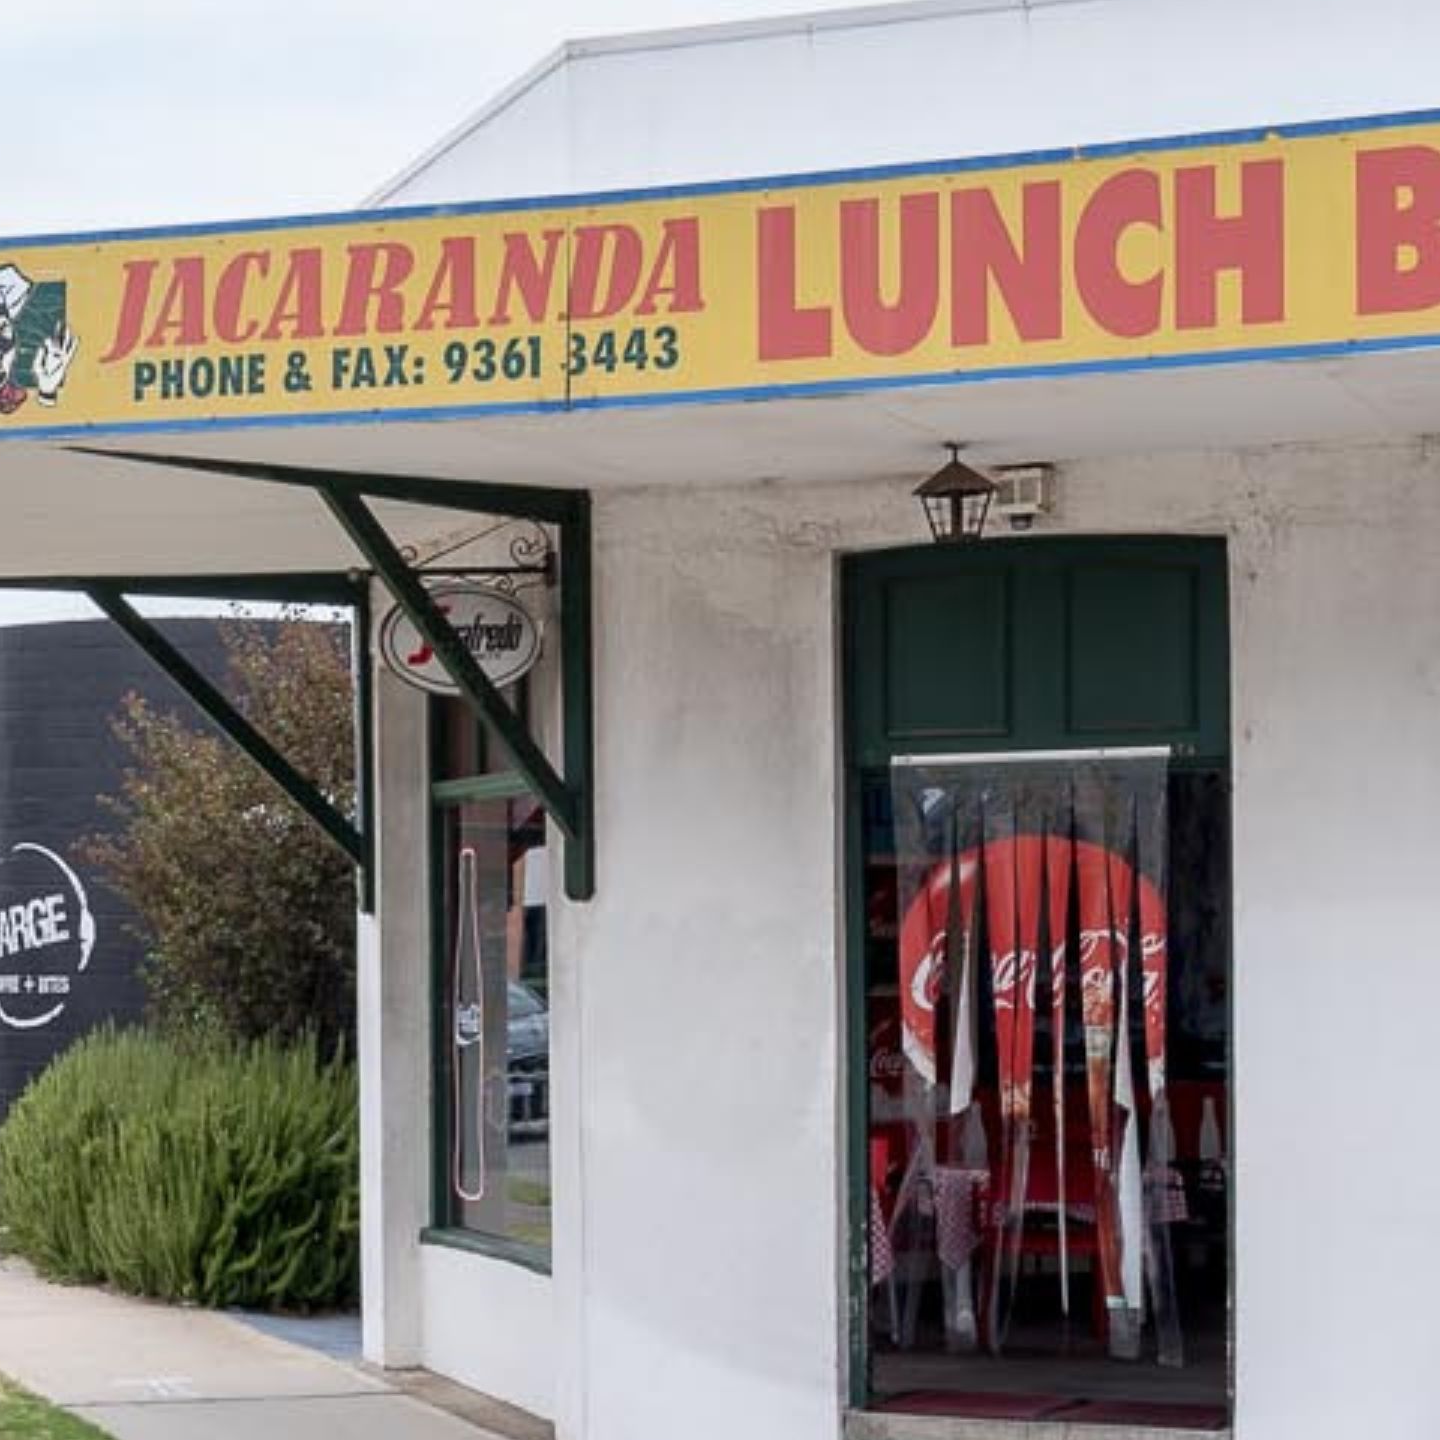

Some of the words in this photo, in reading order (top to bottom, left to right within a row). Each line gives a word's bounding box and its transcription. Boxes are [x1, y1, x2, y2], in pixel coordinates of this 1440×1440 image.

[100, 216, 704, 363] JACARANDA
[756, 157, 1284, 361] LUNCH
[133, 353, 265, 401] PHONE
[284, 351, 312, 391] &
[331, 343, 424, 390] FAX:
[444, 336, 541, 383] 9361
[566, 326, 680, 375] 3443
